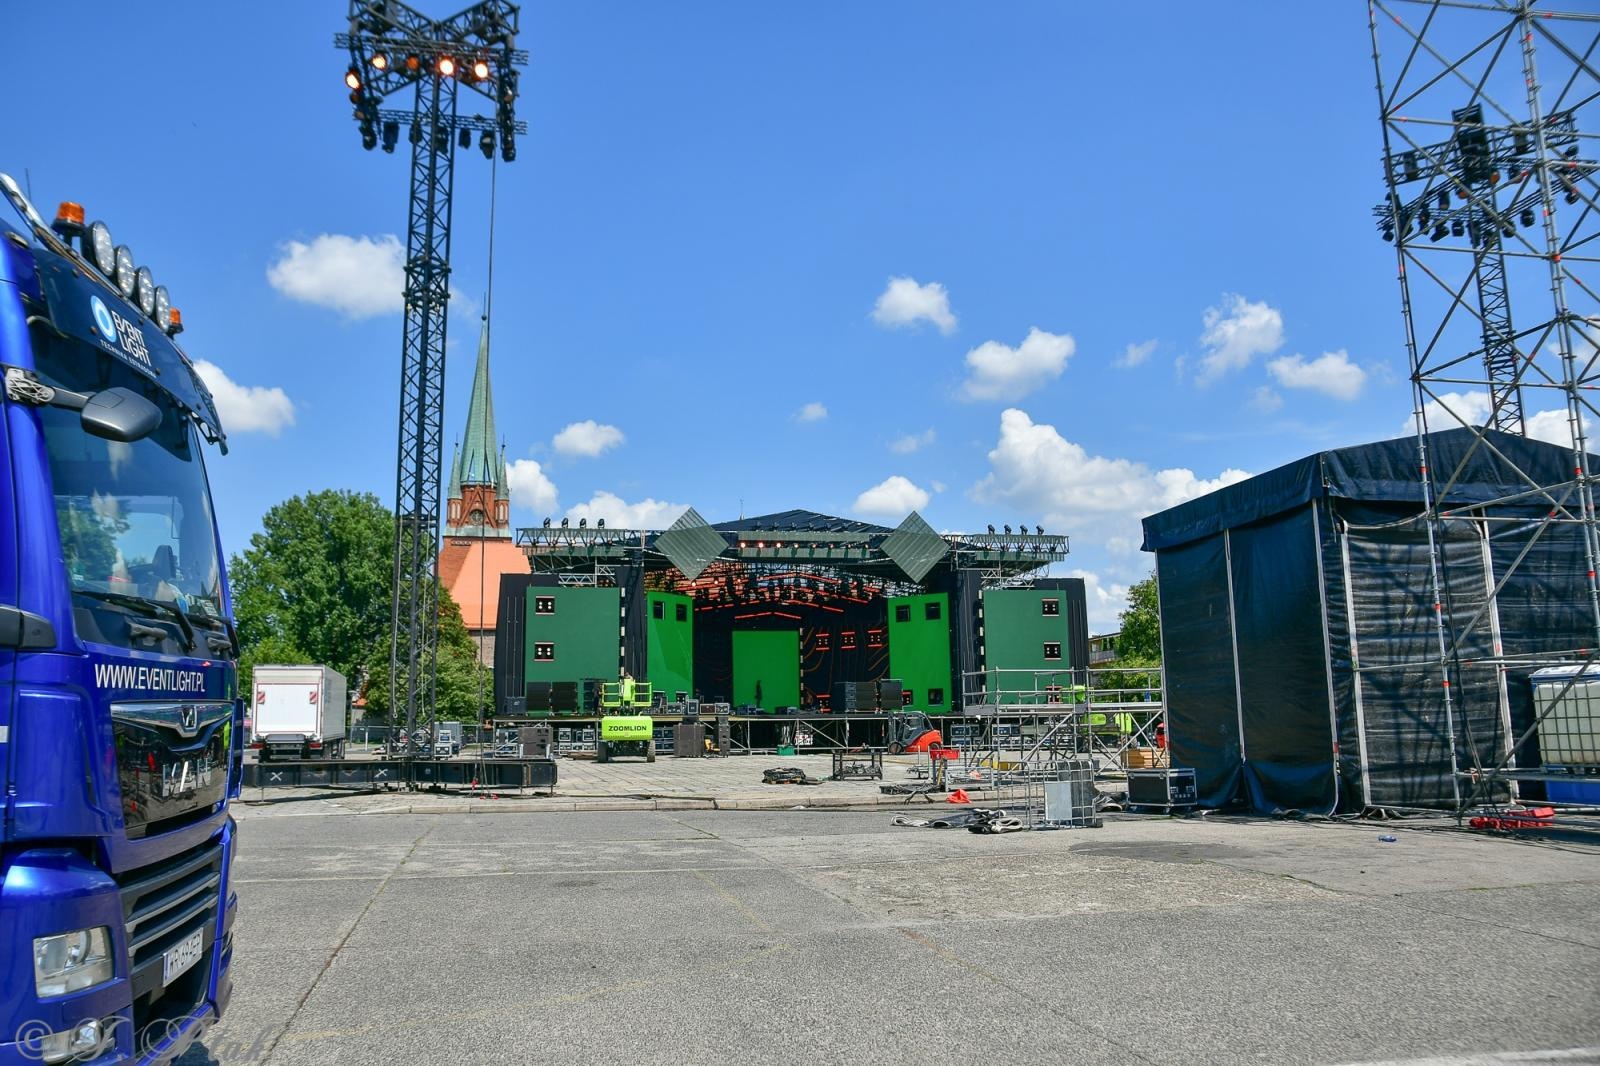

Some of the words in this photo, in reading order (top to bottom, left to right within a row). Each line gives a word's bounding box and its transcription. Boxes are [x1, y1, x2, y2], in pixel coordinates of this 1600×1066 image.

[111, 310, 146, 348] EVENT
[117, 330, 152, 367] LIGHT
[94, 663, 206, 693] WWW.EVENTLIGHT.PL
